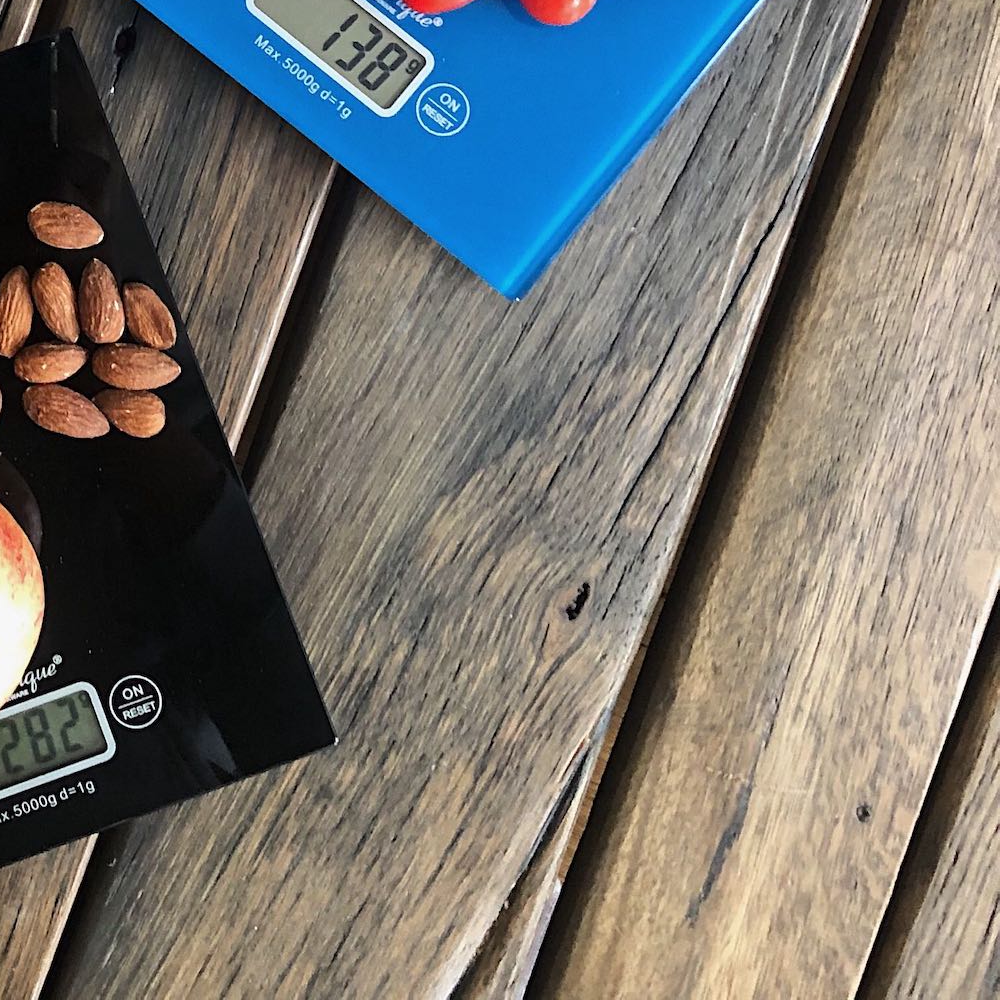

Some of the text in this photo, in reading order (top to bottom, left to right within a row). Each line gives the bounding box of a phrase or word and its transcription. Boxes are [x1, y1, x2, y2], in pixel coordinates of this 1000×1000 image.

[319, 89, 352, 120] d=1g
[439, 92, 461, 113] ON
[421, 103, 455, 131] RESET
[121, 683, 145, 701] ON
[121, 700, 157, 721] RESET
[59, 780, 96, 801] d=1g
